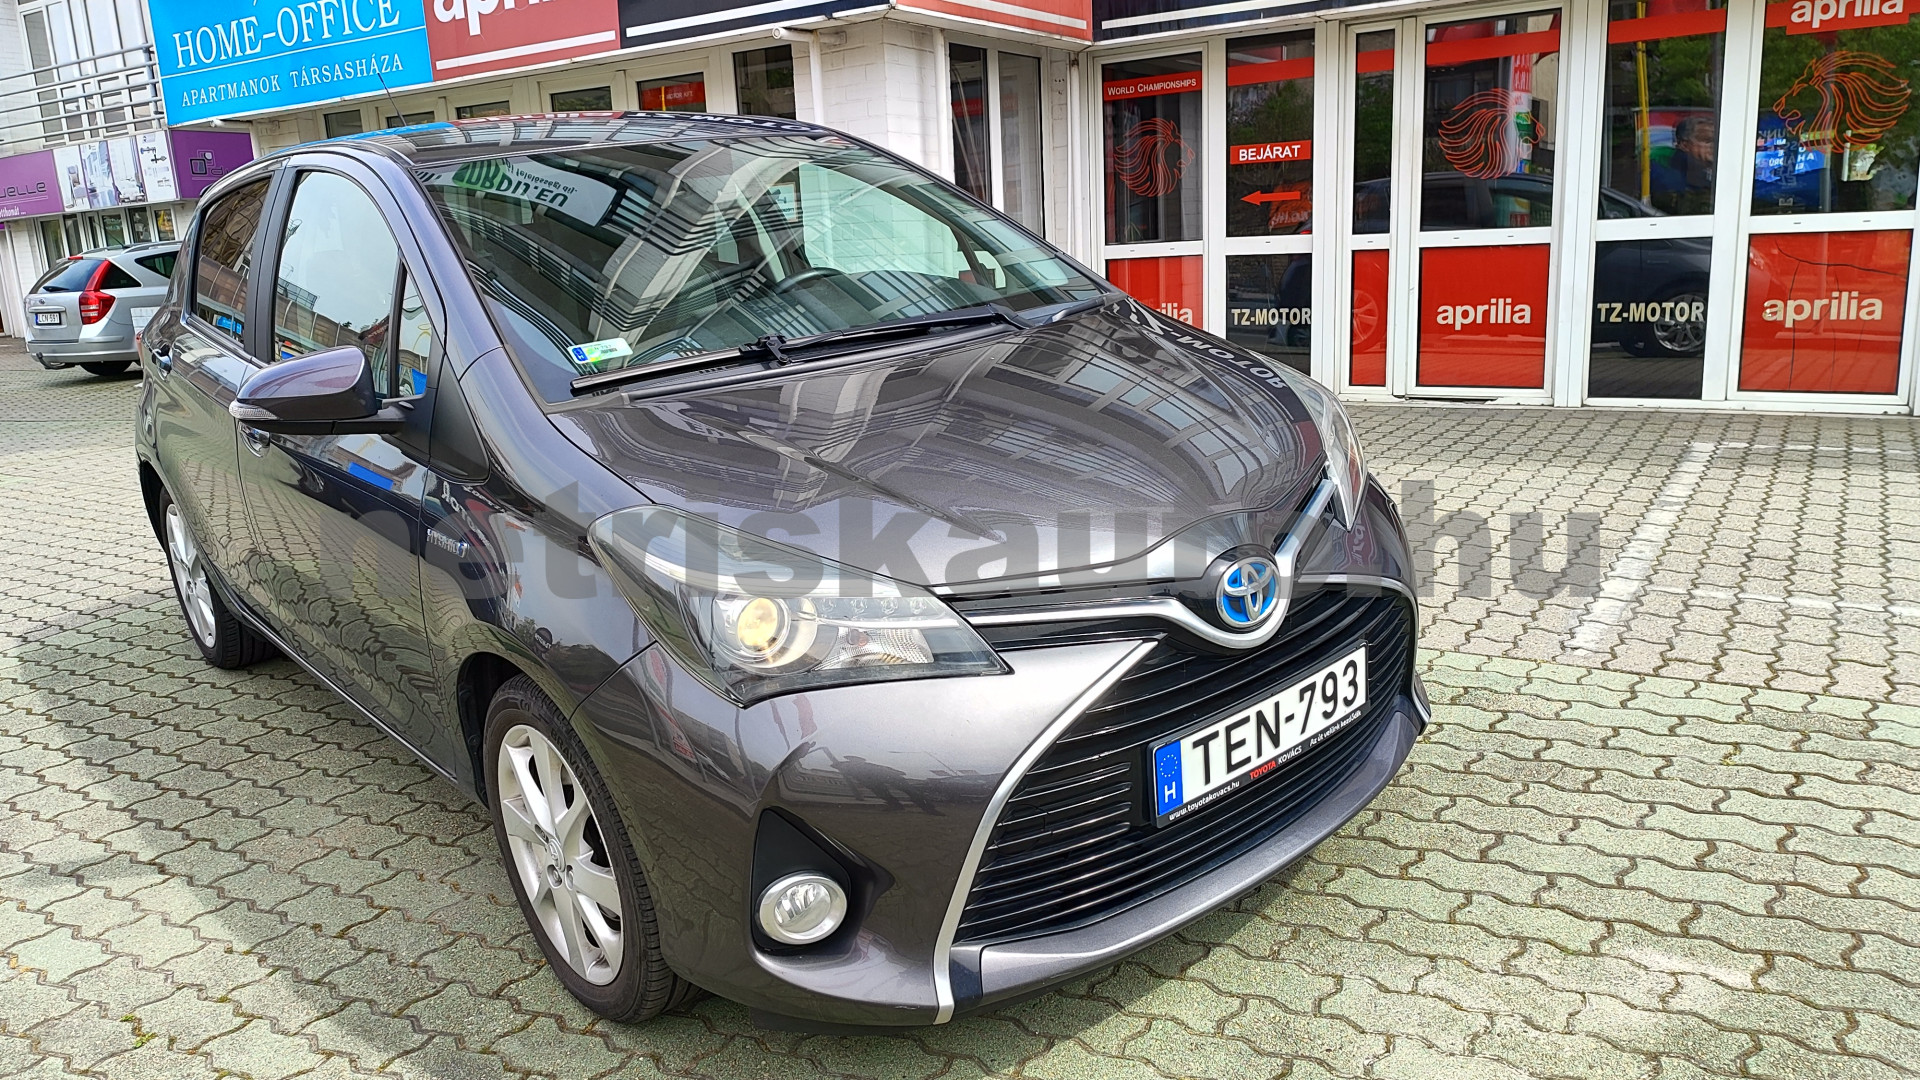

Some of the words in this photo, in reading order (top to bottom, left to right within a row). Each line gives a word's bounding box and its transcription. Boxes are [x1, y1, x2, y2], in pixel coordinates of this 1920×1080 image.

[173, 0, 400, 69] HOME-OFFICE
[181, 74, 281, 107] APARTMANOK
[290, 53, 403, 88] TÁRSASHÁZA
[1239, 145, 1301, 161] BEJÁRAT
[1154, 303, 1193, 325] ilia
[1231, 307, 1312, 326] TZ-MOTOR
[1436, 298, 1531, 331] aprilia
[1597, 302, 1705, 323] TZ-MOTOR
[1762, 291, 1883, 328] aprilia
[1192, 659, 1359, 786] TEN-793
[1249, 760, 1277, 780] TOYOTA
[1278, 745, 1303, 765] KOVÁCS
[1164, 781, 1177, 804] H
[1168, 780, 1240, 821] www.toyotakovacs.hu
